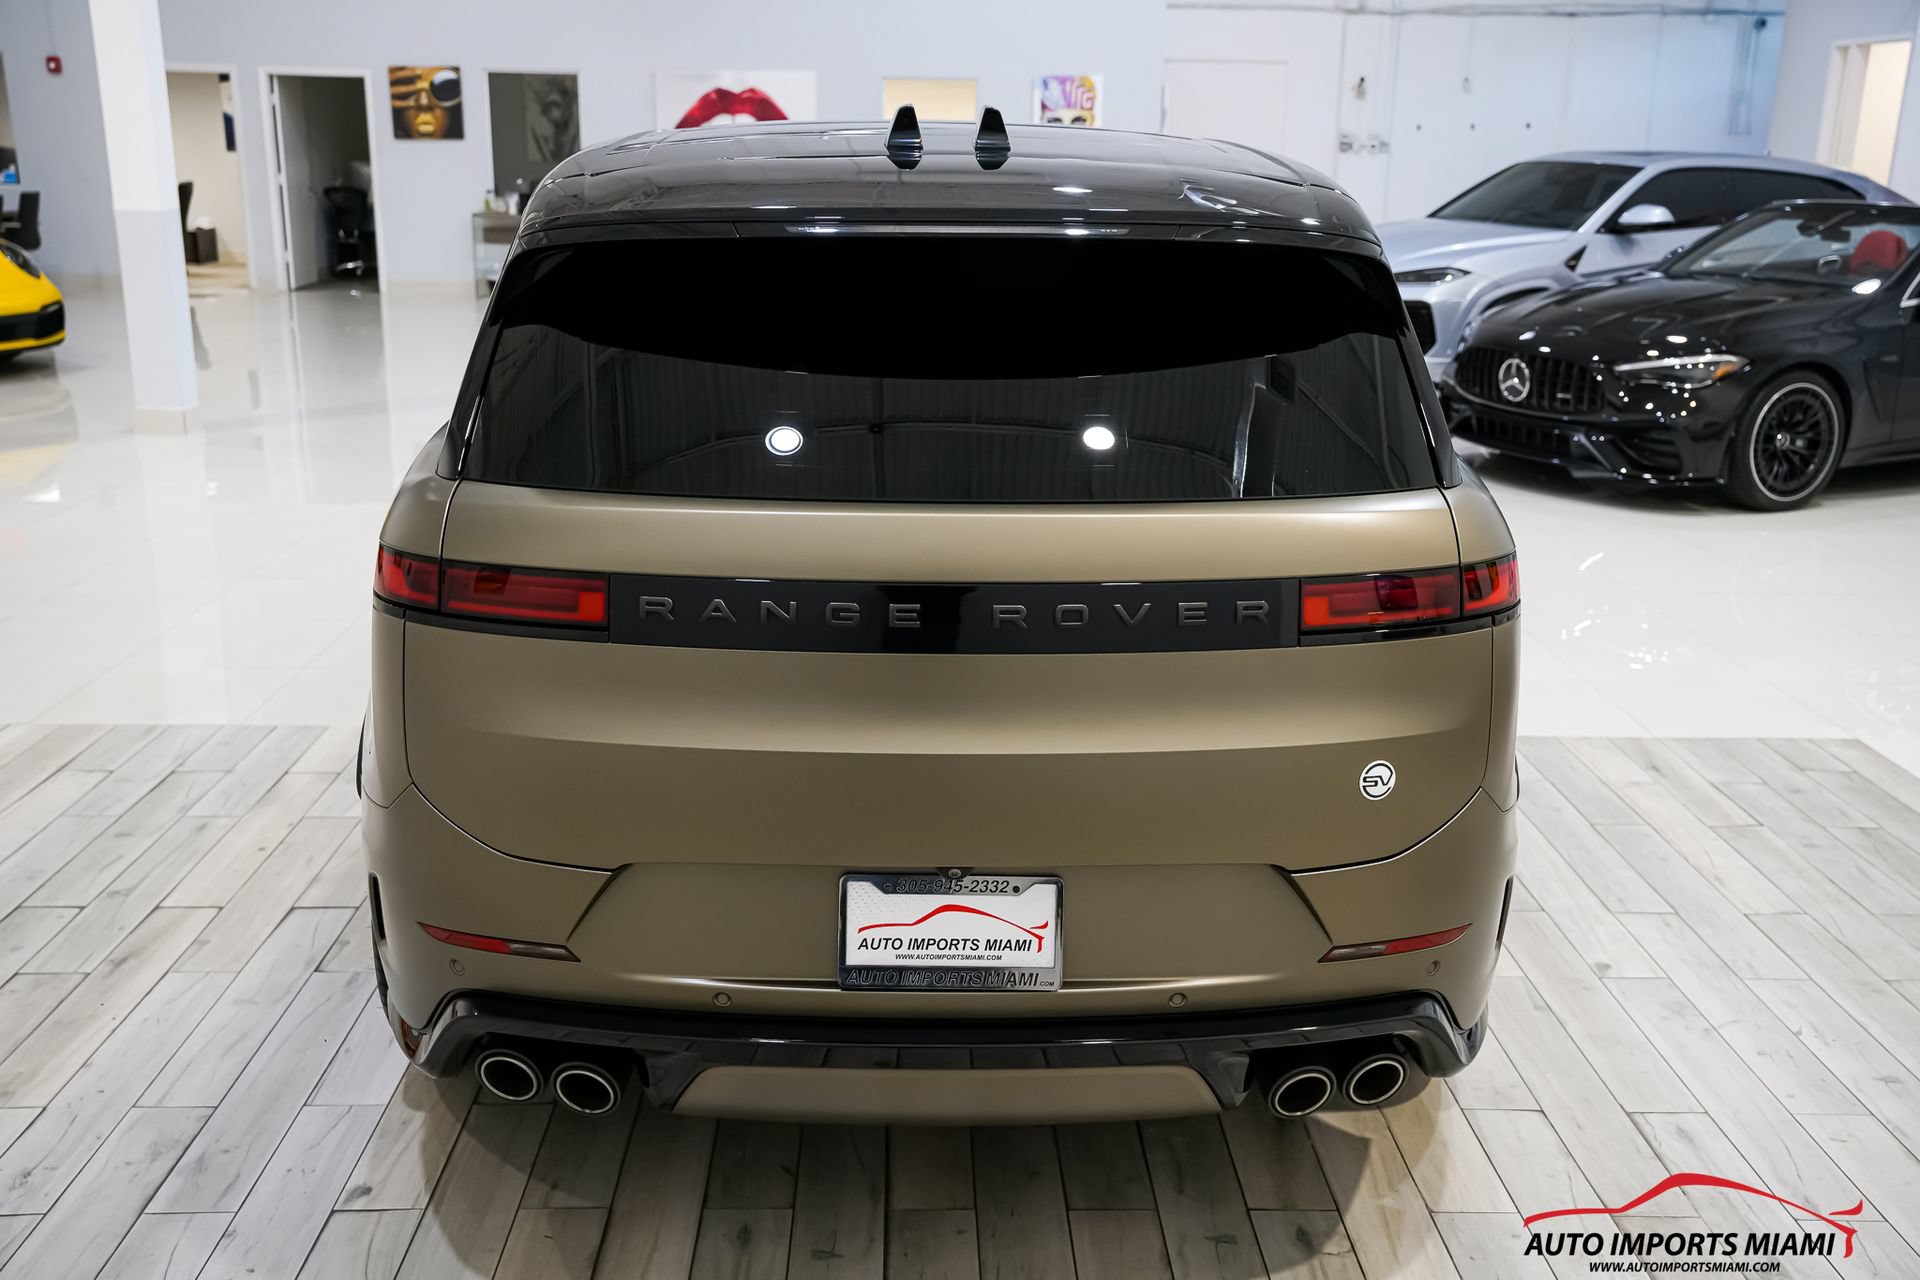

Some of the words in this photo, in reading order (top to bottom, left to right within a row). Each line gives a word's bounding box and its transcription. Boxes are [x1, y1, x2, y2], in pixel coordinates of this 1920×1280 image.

[639, 595, 921, 629] RANGE
[992, 600, 1270, 629] ROVER
[896, 879, 1010, 894] 305-945-2332
[858, 937, 903, 951] AUTO
[907, 938, 980, 951] IMPORTS
[984, 938, 1032, 952] MIAMI
[895, 953, 1002, 961] WWW.AUTOIMPORTSMIAMI.COM
[847, 969, 899, 985] AUTO
